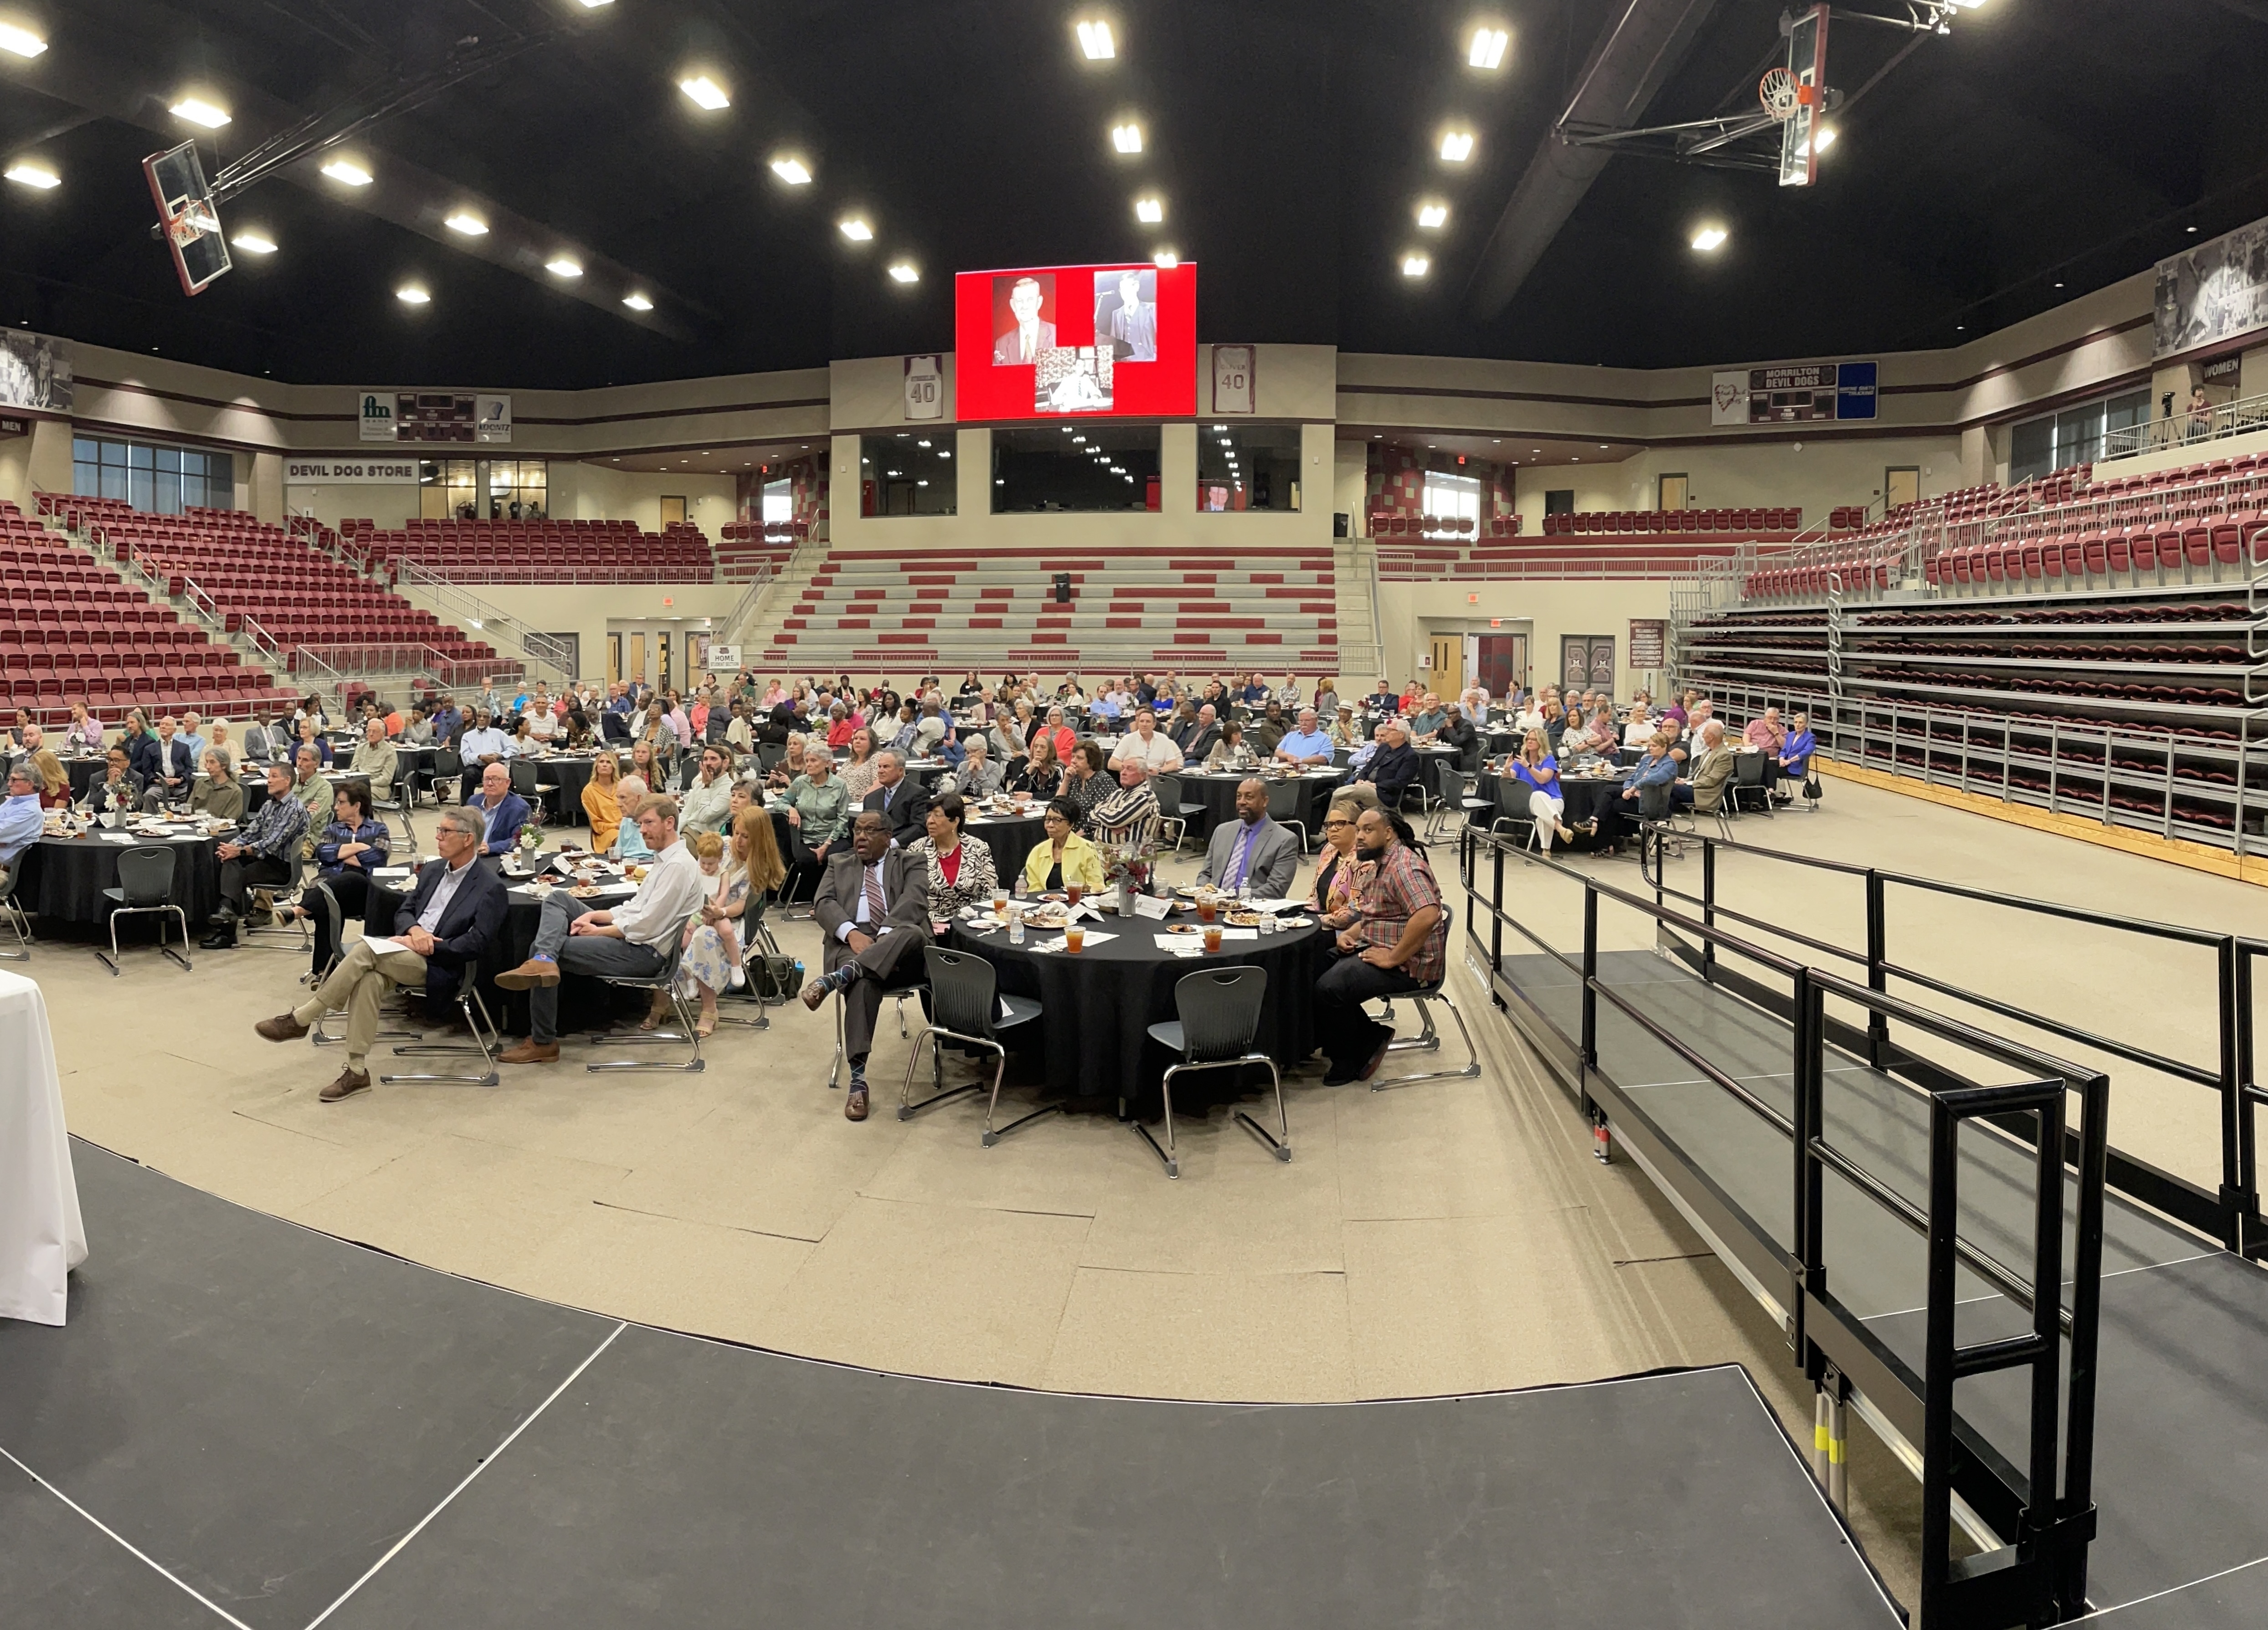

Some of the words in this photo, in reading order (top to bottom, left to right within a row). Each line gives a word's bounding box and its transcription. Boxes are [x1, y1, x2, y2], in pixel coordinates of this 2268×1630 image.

[1766, 367, 1820, 378] MORRILTON
[2204, 358, 2239, 378] WOMEN
[1222, 374, 1244, 390] 40
[1766, 377, 1792, 388] DEVIL
[1794, 375, 1820, 386] DOGS
[911, 383, 935, 403] 40
[2, 420, 21, 432] MEN
[290, 465, 329, 476] DEVIL
[334, 466, 363, 476] DOG
[368, 466, 412, 477] STORE
